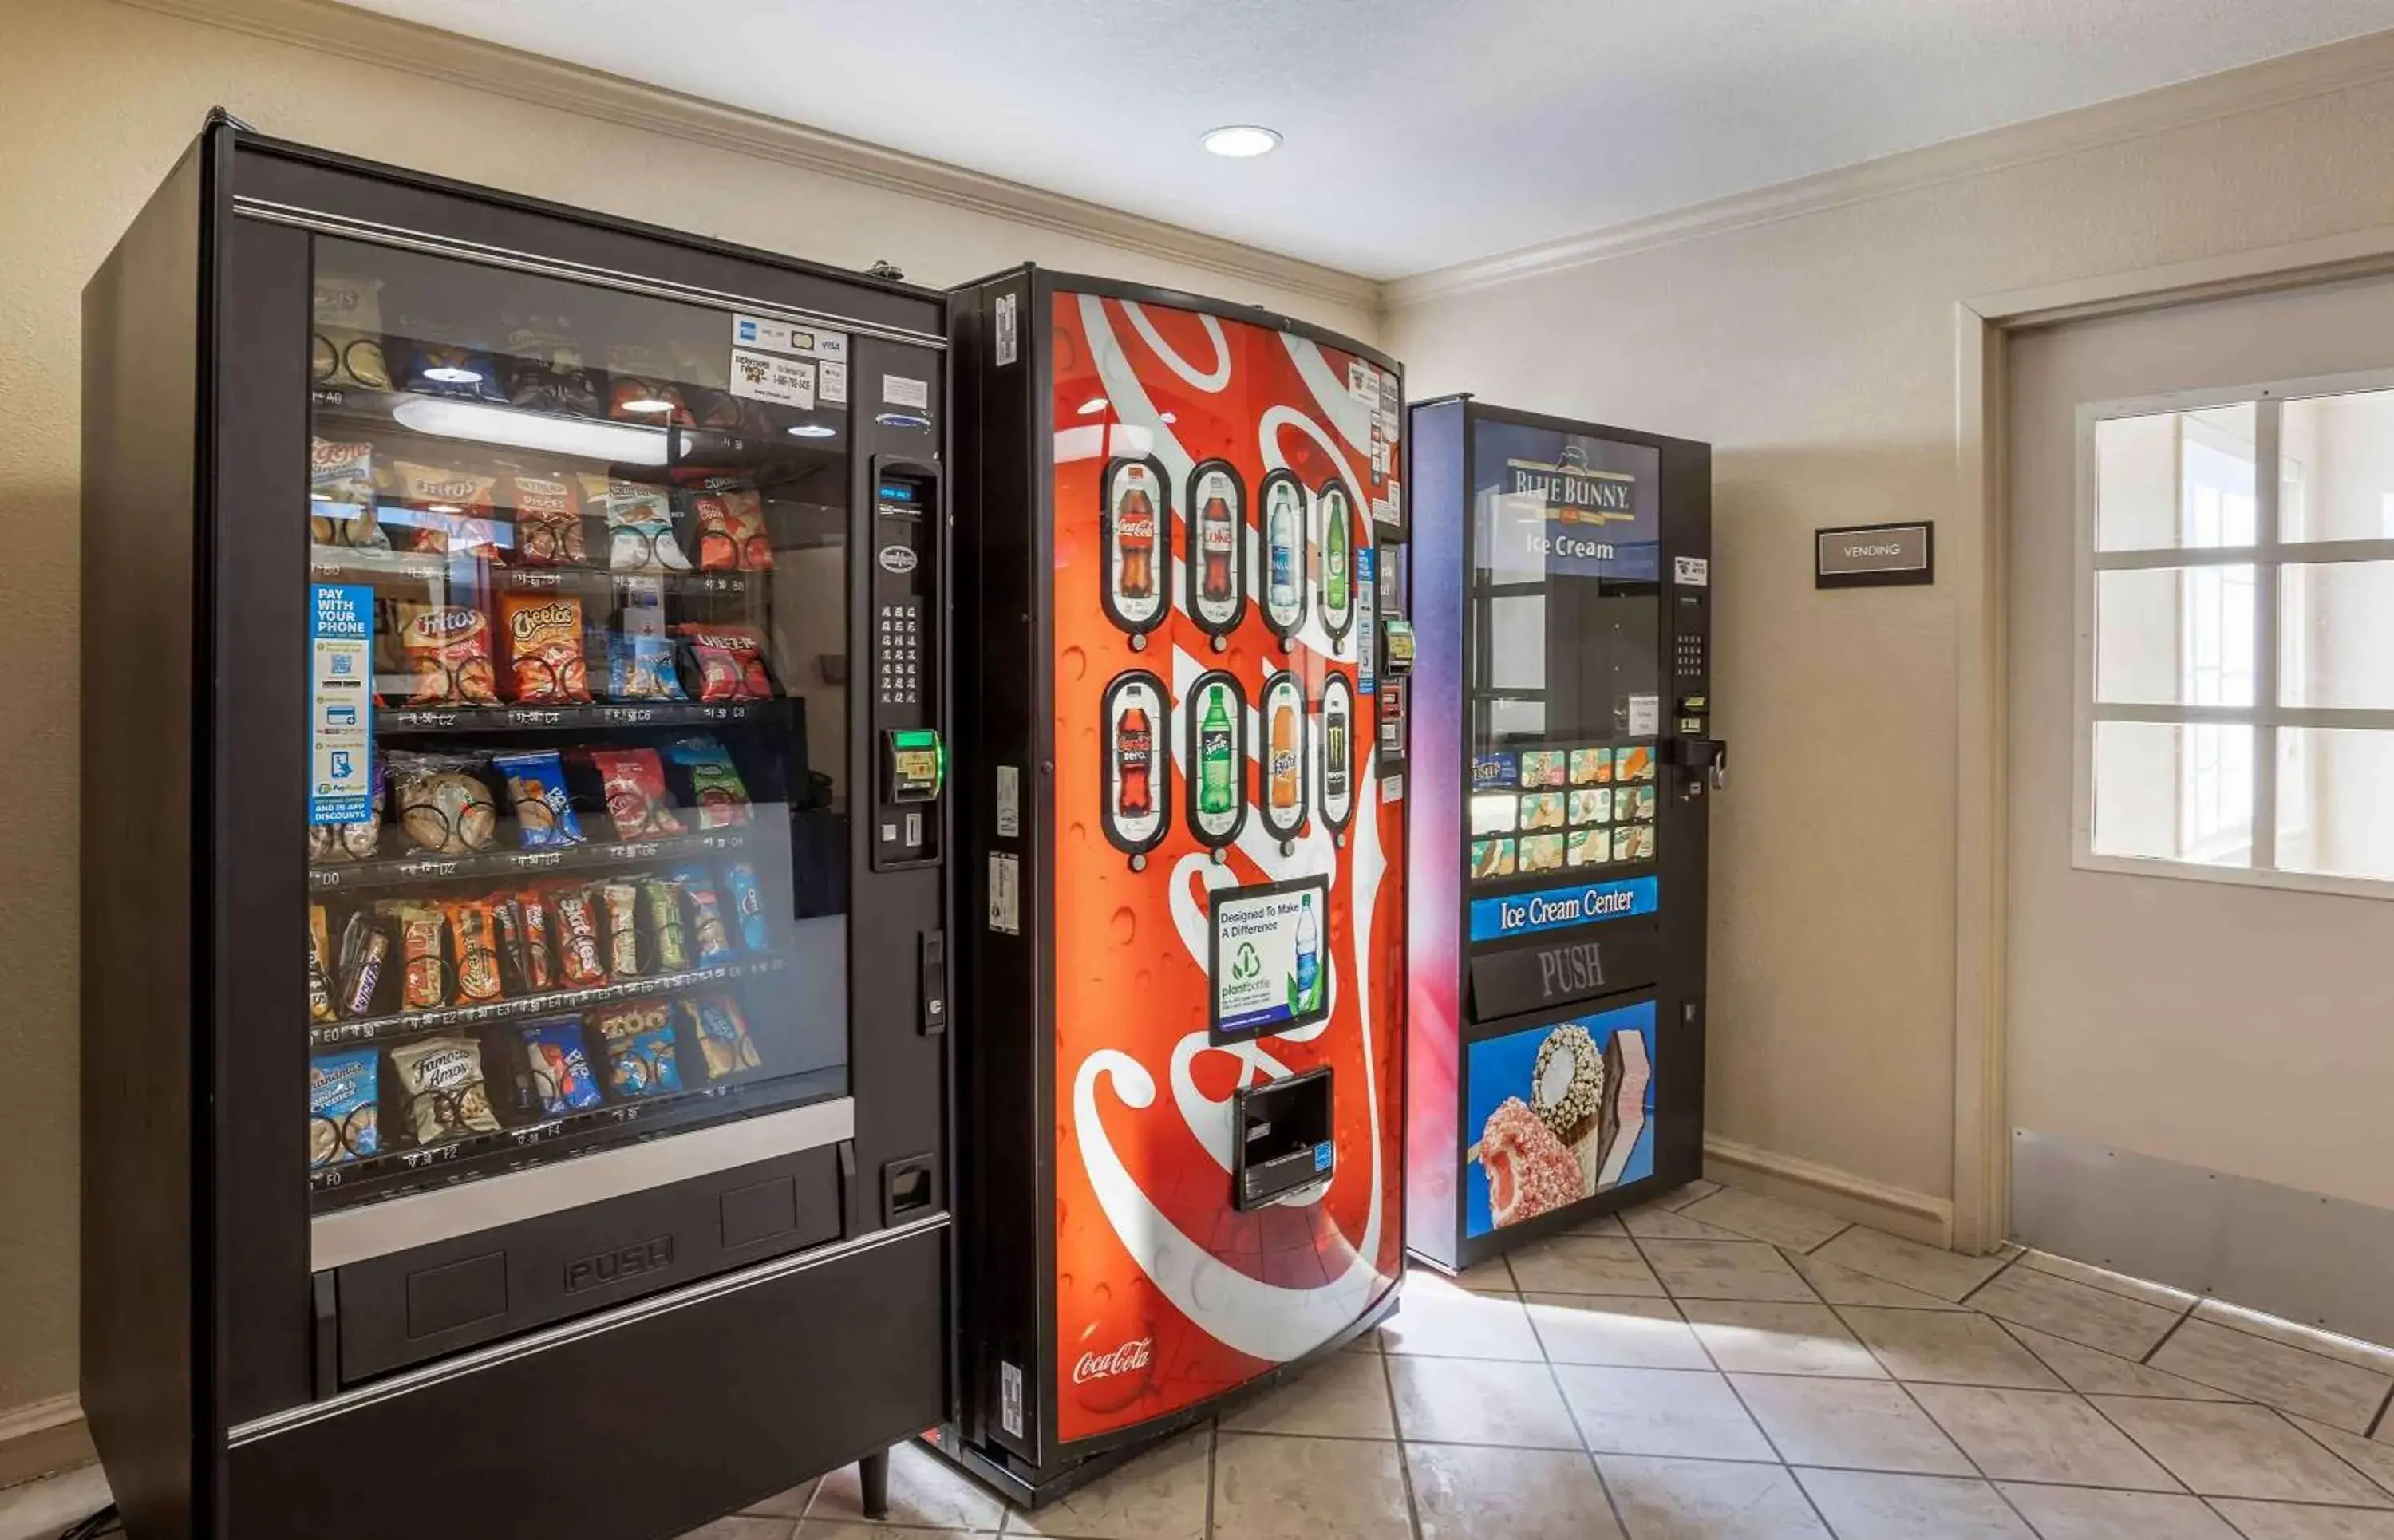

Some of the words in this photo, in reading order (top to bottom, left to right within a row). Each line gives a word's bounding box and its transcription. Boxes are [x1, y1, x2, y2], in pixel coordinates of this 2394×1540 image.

[822, 340, 841, 352] VISA
[1516, 470, 1561, 502] BLUE
[1565, 476, 1628, 509] BUNNY
[1120, 518, 1153, 537] Coca-Cola
[1527, 532, 1551, 554] Ice
[1556, 535, 1614, 559] Cream
[1844, 543, 1900, 557] VENDING
[318, 588, 344, 599] PAY
[318, 600, 354, 610] WITH
[318, 611, 355, 622] YOUR
[420, 609, 476, 635] Fritos
[513, 603, 573, 638] Cheetos
[318, 622, 365, 633] PHONE
[1206, 733, 1230, 760] Sprite
[315, 811, 366, 820] DISCOUNTS
[323, 872, 340, 885] D0
[1221, 908, 1265, 924] Designed
[1266, 906, 1276, 918] To
[1278, 902, 1299, 915] Make
[1500, 902, 1525, 930] Ice
[1529, 897, 1580, 924] Cream
[1584, 890, 1634, 917] Center
[1222, 928, 1230, 938] A
[1231, 922, 1278, 937] Difference
[1539, 943, 1605, 997] PUSH
[1222, 979, 1271, 999] plantbottle
[325, 1028, 340, 1042] E0
[430, 1063, 467, 1086] Amos
[326, 1172, 342, 1187] F0
[569, 1239, 671, 1289] PUSH
[1073, 1337, 1152, 1384] Coca-Cola
